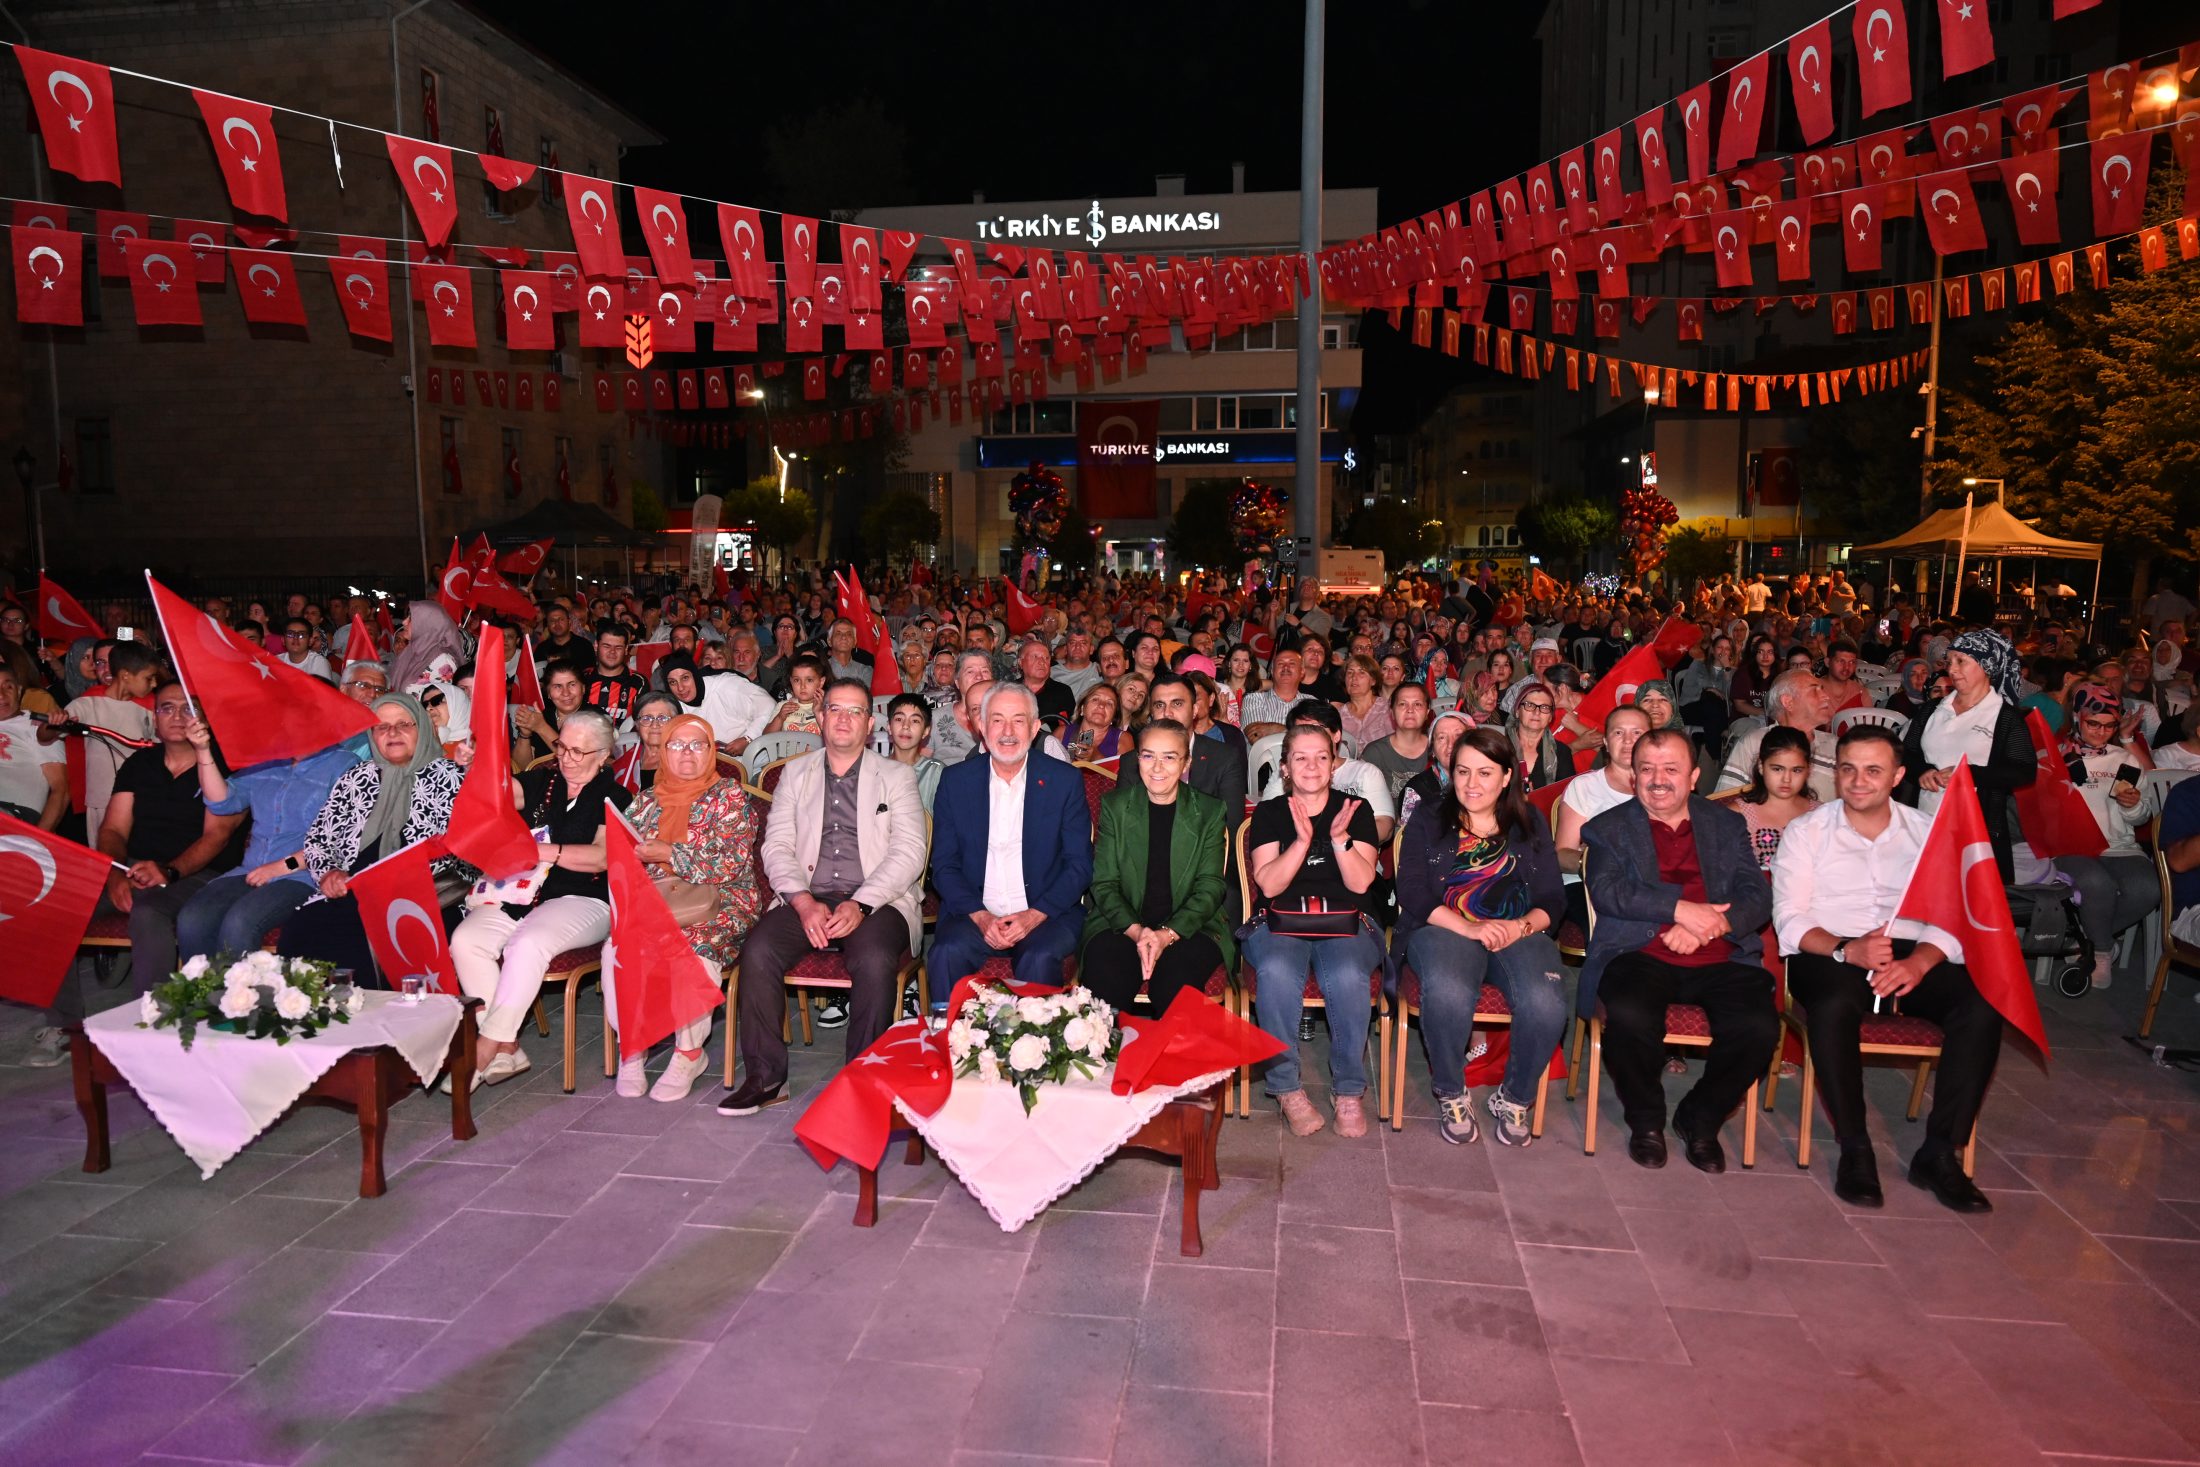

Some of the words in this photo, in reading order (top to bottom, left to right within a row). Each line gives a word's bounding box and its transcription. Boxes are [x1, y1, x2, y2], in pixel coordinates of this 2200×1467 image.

[976, 214, 1080, 239] TÜRKİYE
[1111, 212, 1220, 234] BANKASI
[1167, 442, 1230, 454] BANKASI
[1344, 577, 1359, 585] 112
